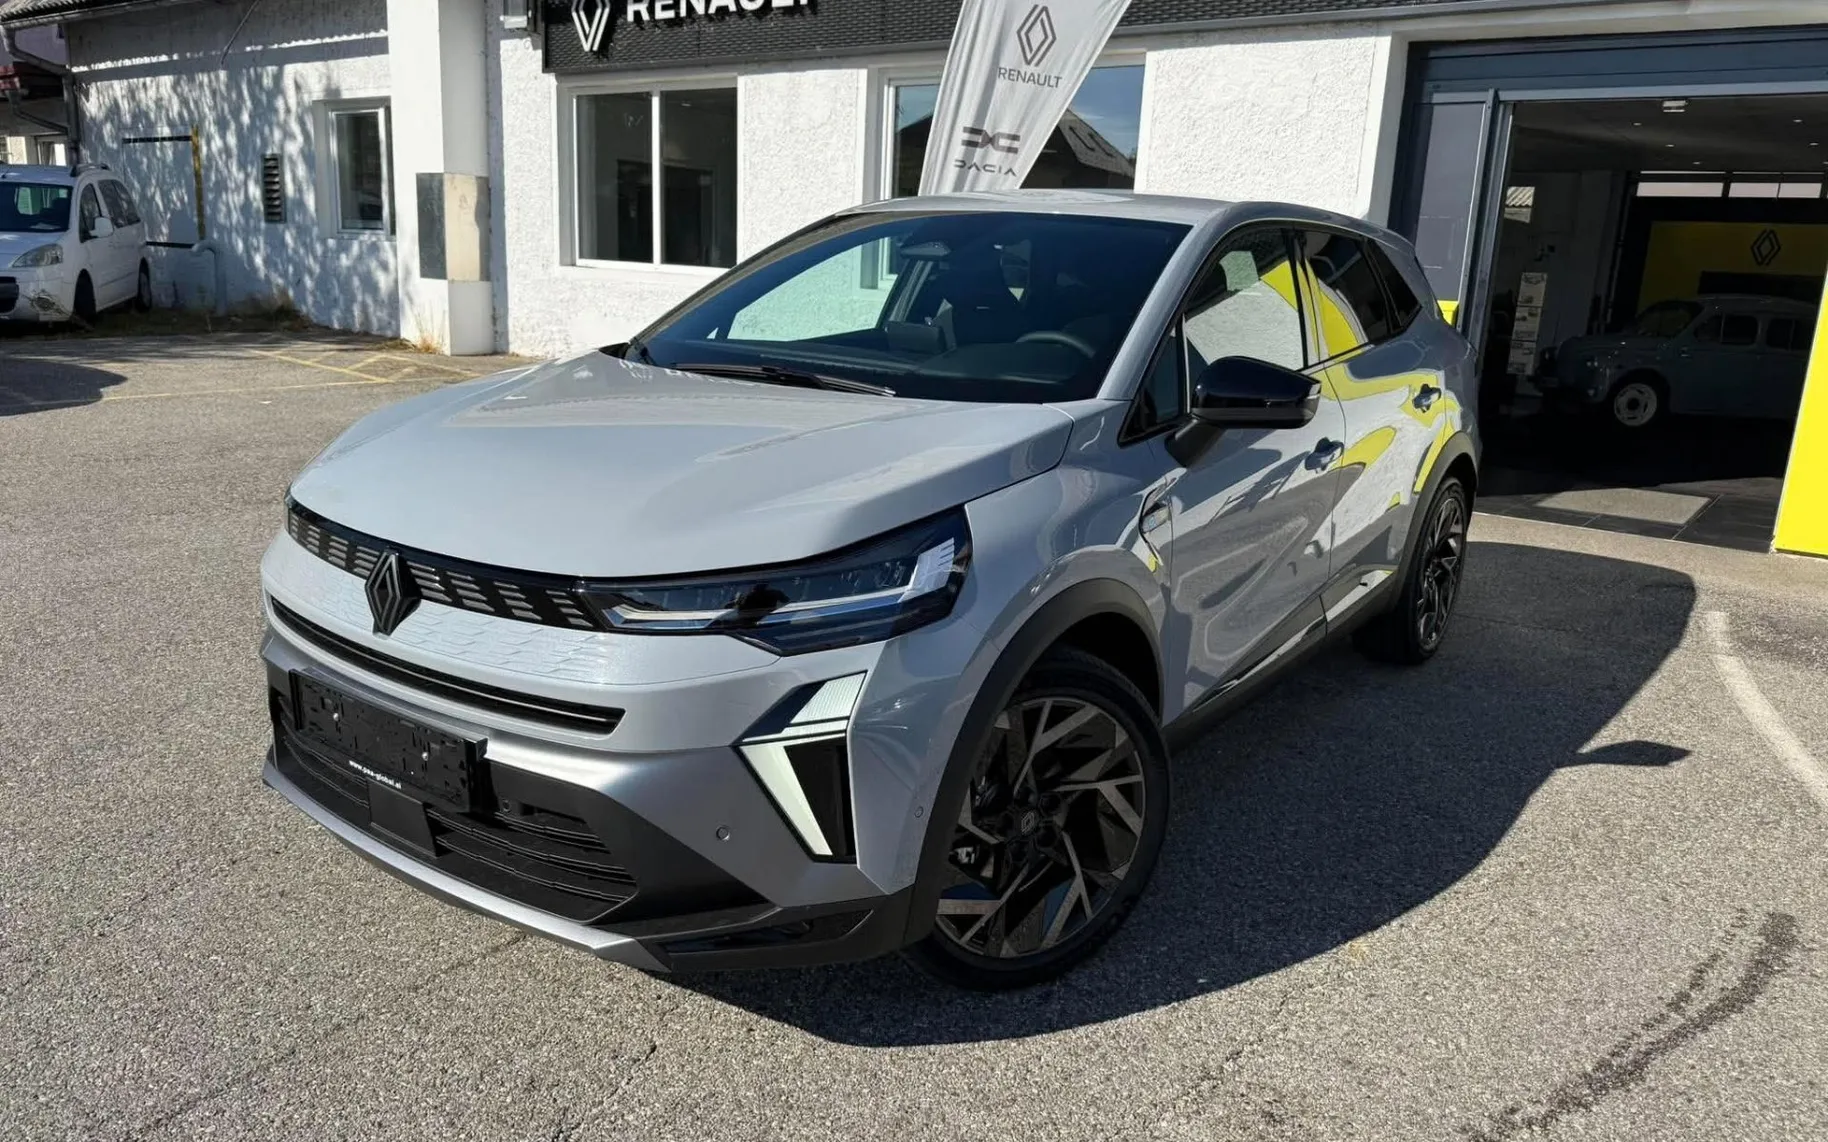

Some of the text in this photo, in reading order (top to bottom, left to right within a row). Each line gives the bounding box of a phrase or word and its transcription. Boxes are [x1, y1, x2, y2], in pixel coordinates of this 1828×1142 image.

[626, 0, 808, 22] RENA
[997, 67, 1063, 88] RENAULT
[953, 159, 1017, 177] DACIA
